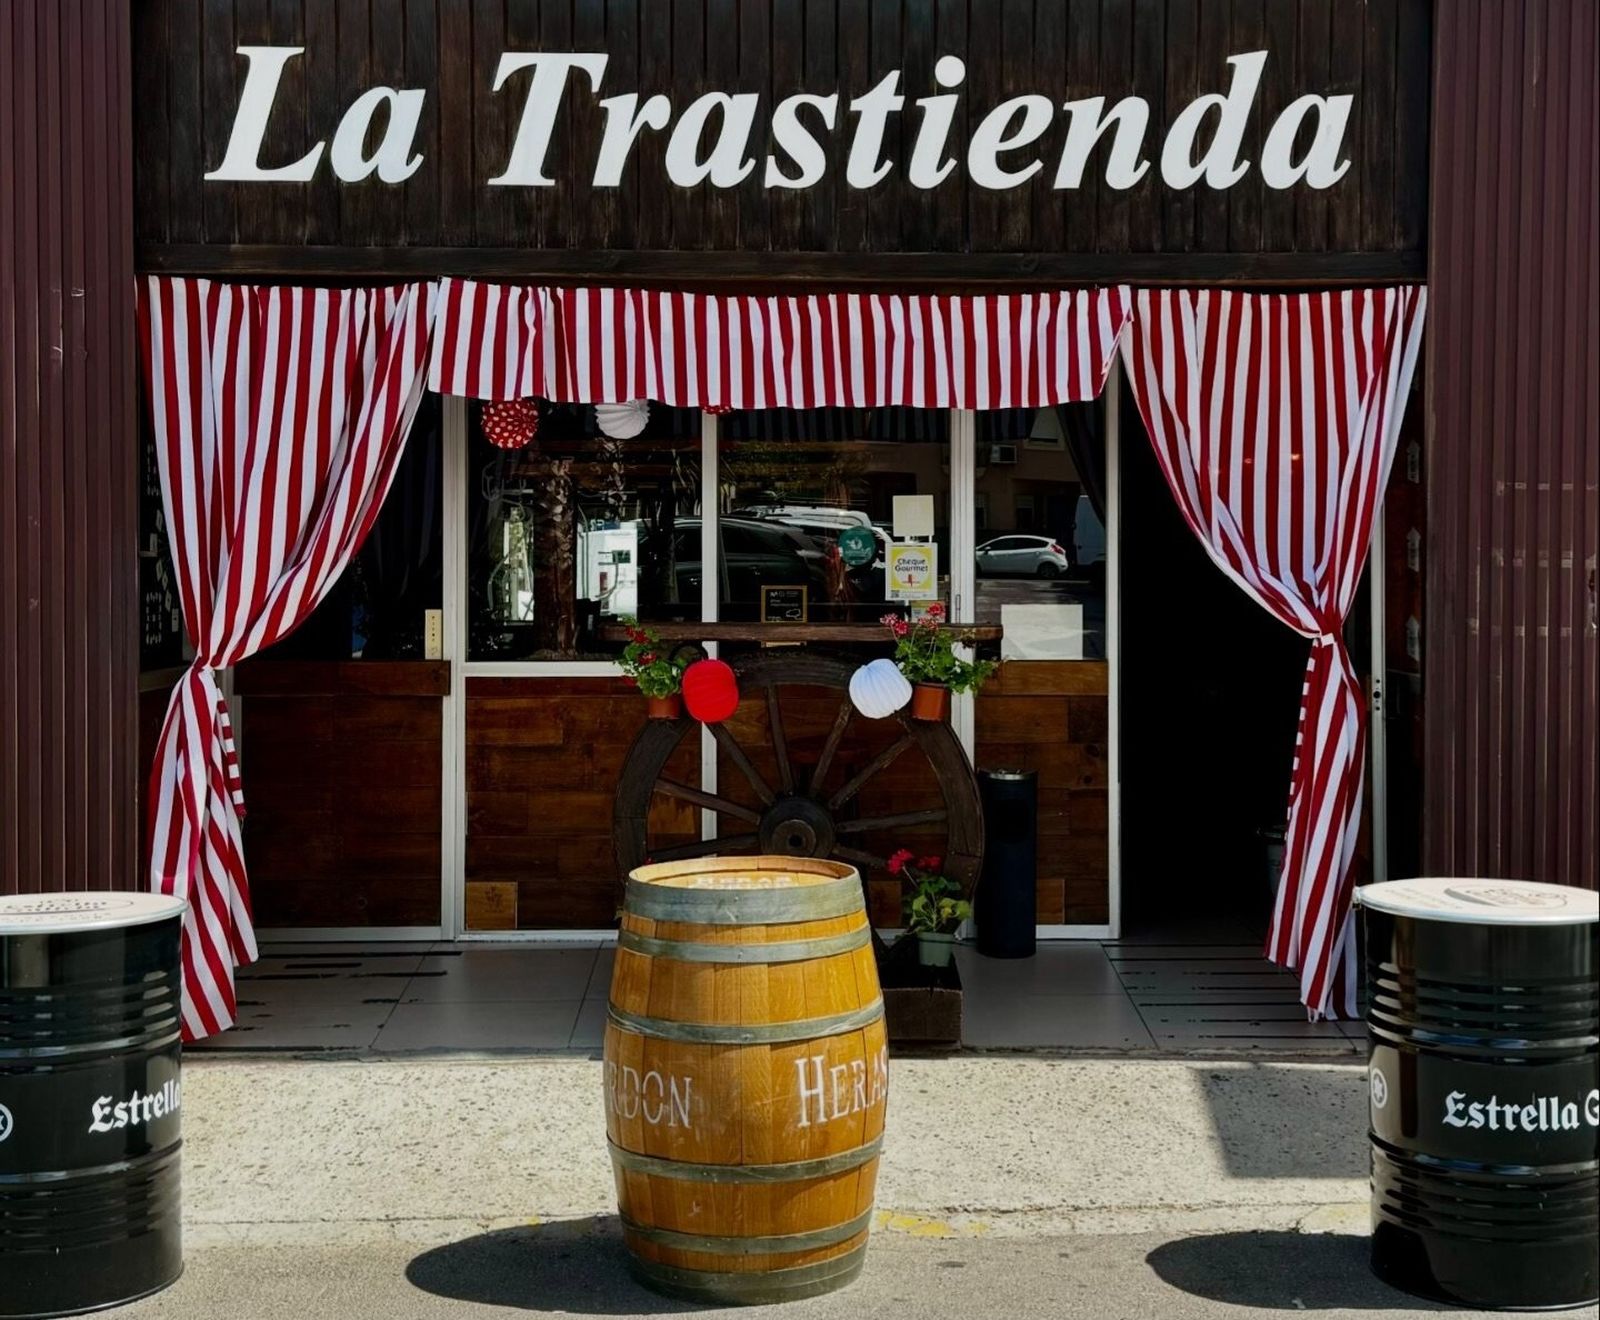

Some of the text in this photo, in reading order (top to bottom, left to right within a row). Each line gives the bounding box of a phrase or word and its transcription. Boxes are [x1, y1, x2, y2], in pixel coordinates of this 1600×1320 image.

[204, 46, 1355, 191] La Trastienda
[897, 558, 926, 566] Cheque
[1442, 1090, 1580, 1132] Estrella
